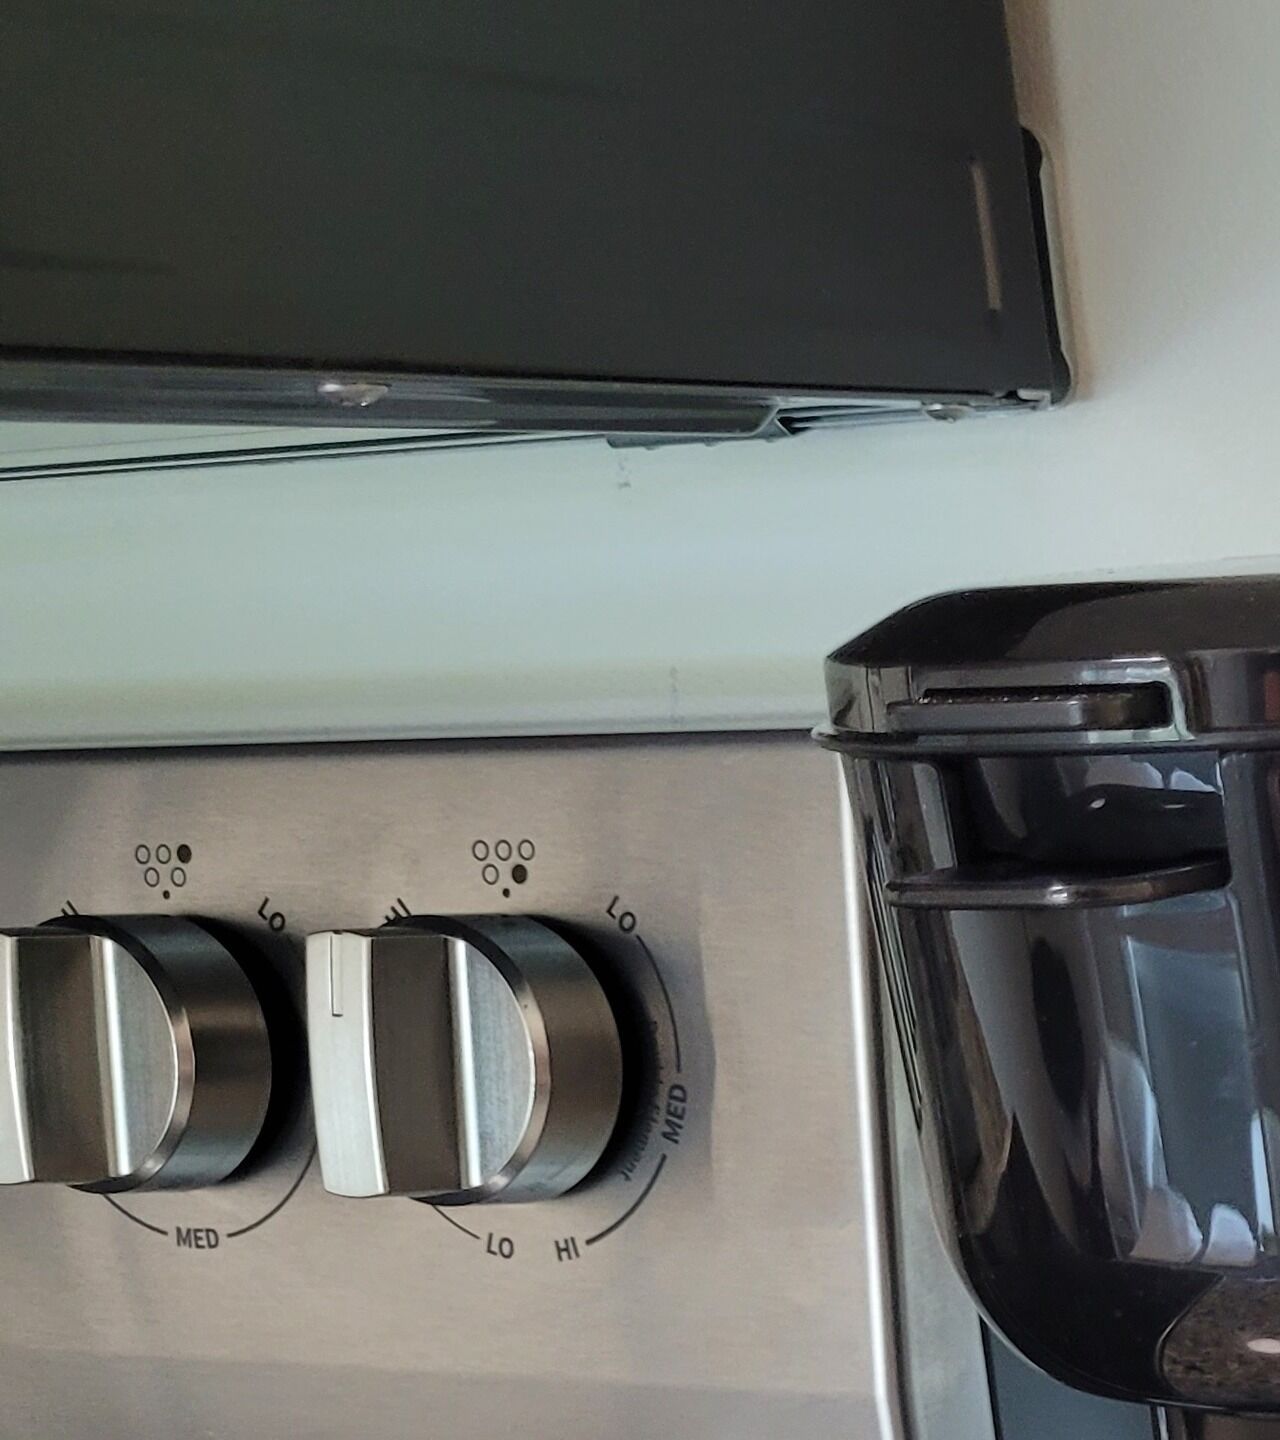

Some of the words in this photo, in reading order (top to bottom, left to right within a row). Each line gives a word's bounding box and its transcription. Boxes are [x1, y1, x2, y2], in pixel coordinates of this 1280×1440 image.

[257, 898, 286, 932] LO
[606, 896, 636, 932] LO
[663, 1083, 687, 1145] MED
[176, 1225, 219, 1248] MED
[486, 1232, 514, 1259] LO
[555, 1236, 579, 1260] HI
